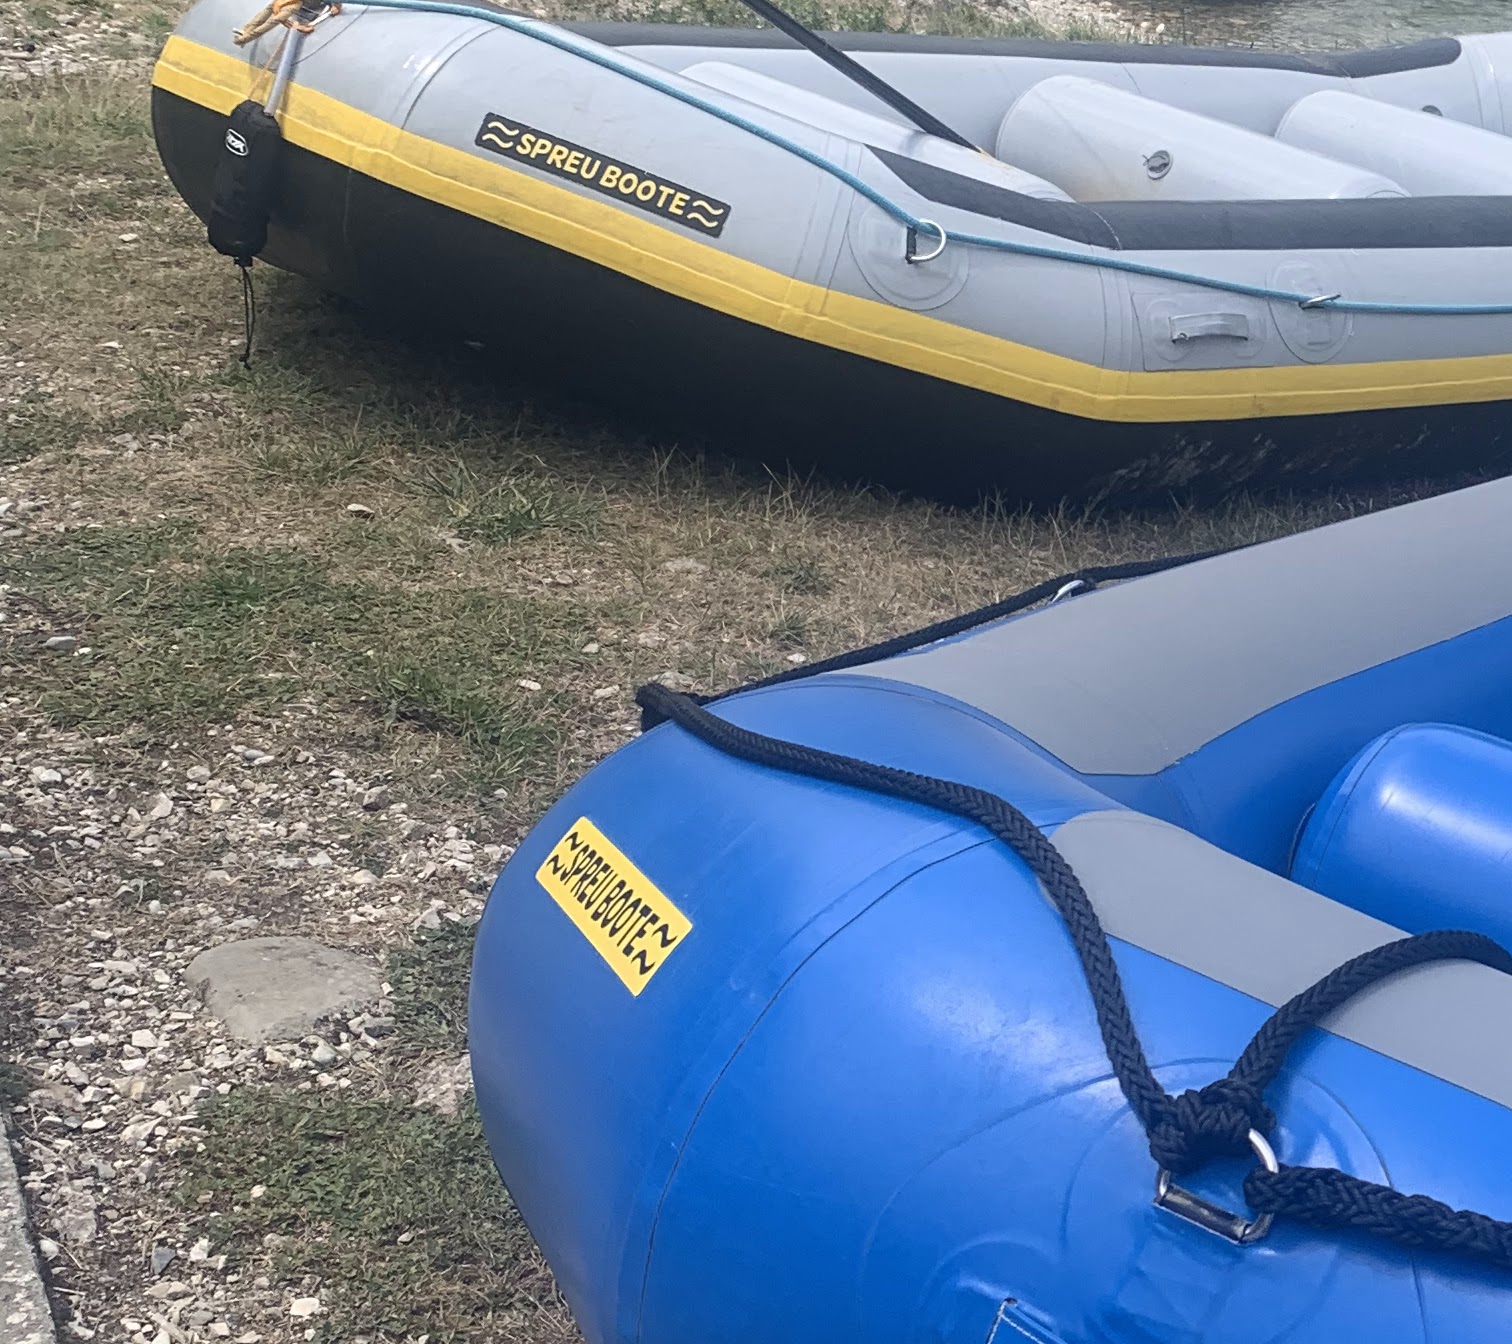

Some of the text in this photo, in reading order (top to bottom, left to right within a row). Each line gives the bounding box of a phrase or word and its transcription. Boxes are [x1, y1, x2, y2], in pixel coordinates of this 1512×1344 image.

[516, 133, 691, 215] SPREU BOOTE
[560, 844, 661, 957] SPREU BOOTE
